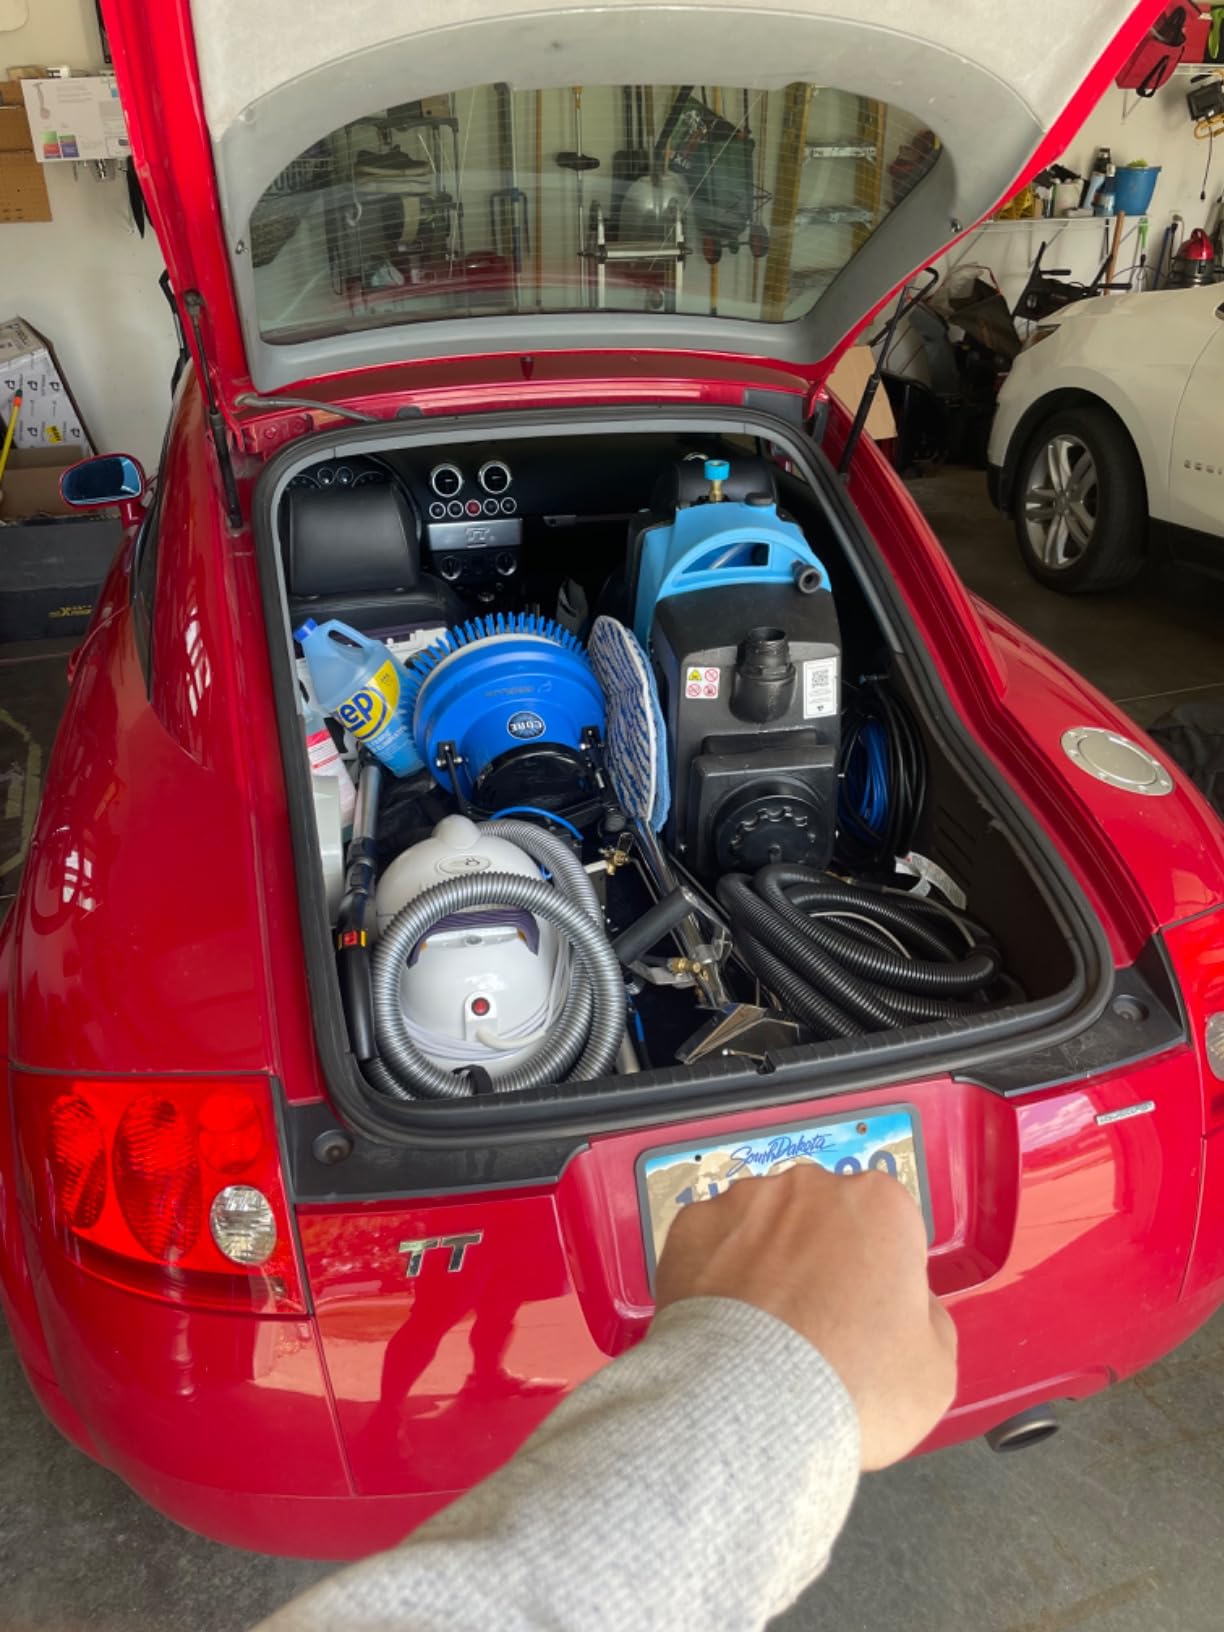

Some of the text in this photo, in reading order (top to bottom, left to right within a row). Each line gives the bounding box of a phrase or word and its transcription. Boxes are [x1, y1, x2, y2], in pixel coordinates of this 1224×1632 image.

[333, 692, 374, 729] ep
[770, 1134, 837, 1161] Dakota
[398, 1230, 484, 1278] TT
